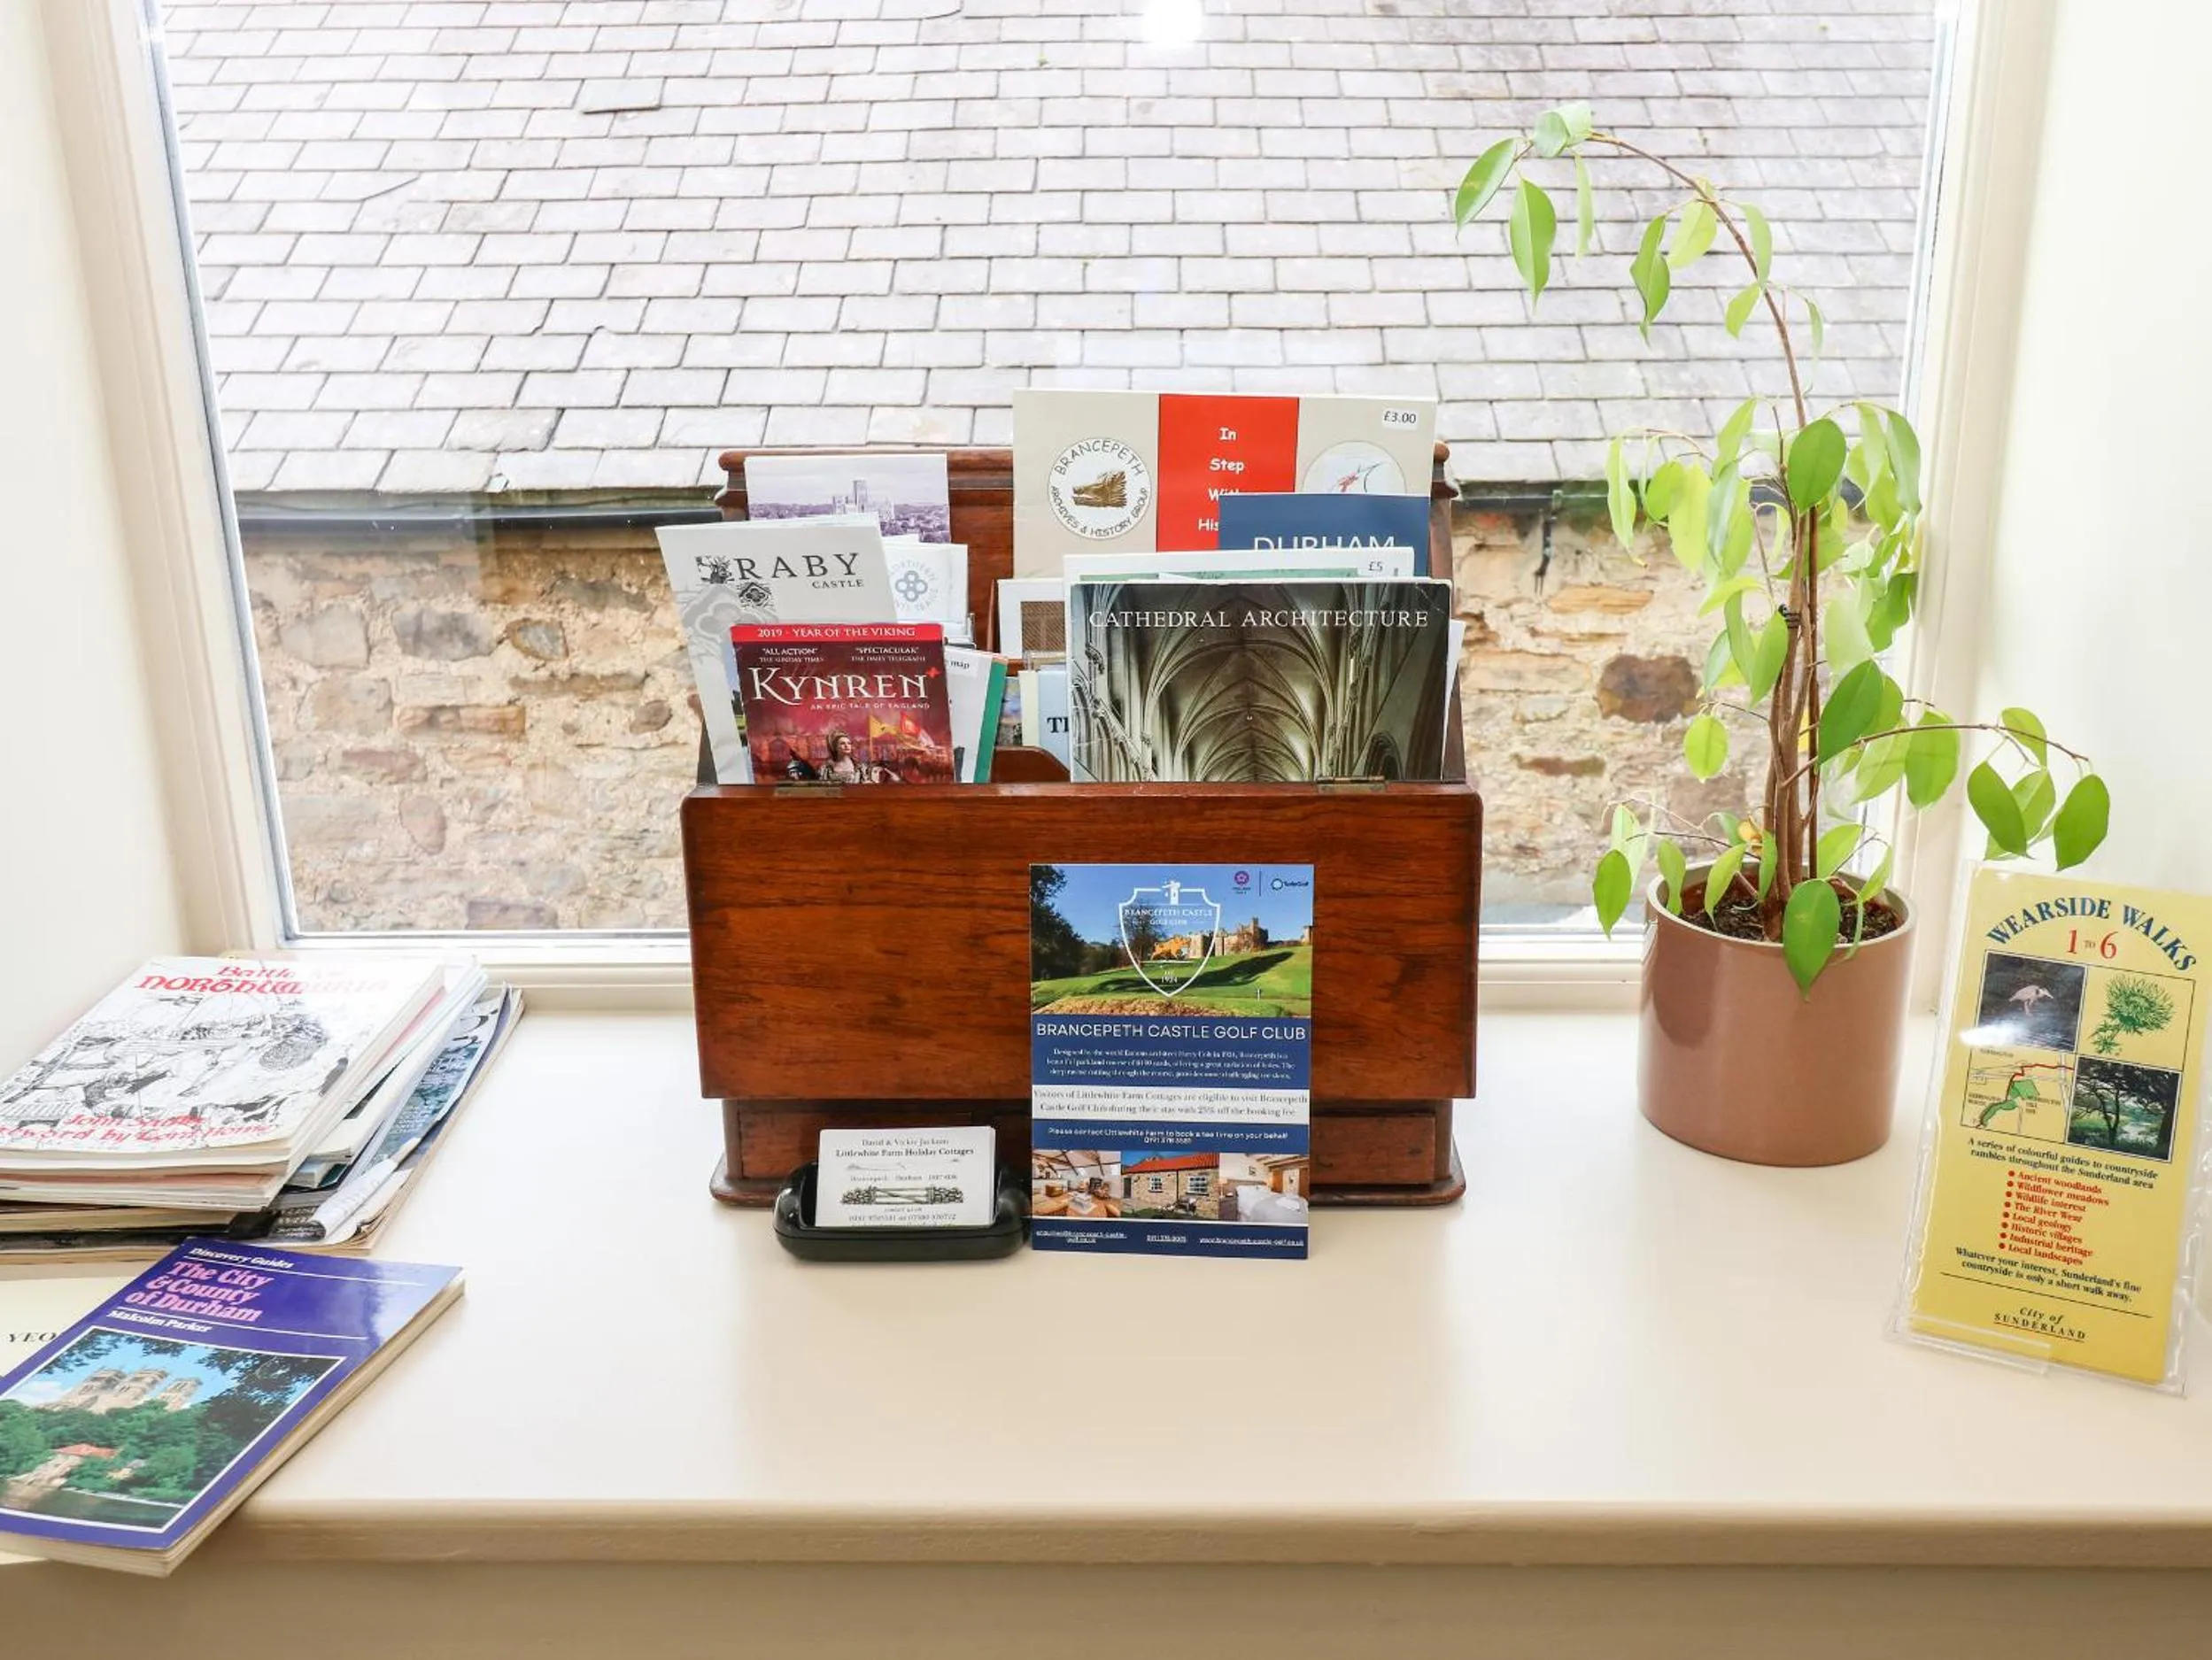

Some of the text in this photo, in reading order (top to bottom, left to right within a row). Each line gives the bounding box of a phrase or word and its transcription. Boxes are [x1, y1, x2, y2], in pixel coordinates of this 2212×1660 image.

[1383, 411, 1417, 424] £3.00
[1219, 428, 1237, 441] In
[1055, 440, 1145, 475] BRANCEPETH
[1209, 458, 1245, 473] Step
[1051, 486, 1080, 529] ARCHIVES
[1090, 518, 1132, 537] HISTORY
[1130, 488, 1149, 518] GROUP
[733, 552, 859, 580] RABY
[1368, 561, 1383, 572] £5
[812, 579, 864, 589] CASTLE
[1089, 610, 1428, 628] CATHEDRAL ARCHITECTURE
[758, 627, 916, 638] 2019 YEAR OF THE VIKING
[1985, 897, 2196, 971] WEARSIDE WALKS
[2066, 930, 2078, 954] 1
[2100, 931, 2118, 959] 6
[1036, 1023, 1306, 1040] BRANCEPETH CASTLE GOLF CLUB
[1065, 1090, 1075, 1099] of
[1145, 1092, 1182, 1103] Cottages
[1260, 1094, 1308, 1105] Brancepeth
[1067, 1103, 1086, 1113] Golf
[905, 1148, 937, 1157] Holiday
[939, 1147, 974, 1156] Cottages
[1968, 1137, 2159, 1180] A series of colourful guides to countryside
[1970, 1149, 2154, 1190] rambles throughout the Sunderland area
[2018, 1171, 2102, 1193] Ancient woodlands
[2015, 1192, 2086, 1212] Wildlife interest
[2017, 1181, 2109, 1205] Wildflower meadows
[2013, 1213, 2072, 1232] Local geology
[2015, 1202, 2083, 1223] The River Wear
[2011, 1223, 2083, 1244] Historic villages
[2008, 1244, 2083, 1265] Local landscapes
[2009, 1233, 2093, 1257] Industrial heritage
[189, 1247, 295, 1269] Discovery Guides
[166, 1261, 275, 1289] The City
[1955, 1247, 1997, 1262] Whatever
[1997, 1256, 2019, 1267] your
[2061, 1269, 2122, 1289] Sunderland's
[2123, 1281, 2142, 1293] fine
[1961, 1260, 2014, 1277] countryside
[2015, 1270, 2024, 1279] is
[2026, 1273, 2046, 1286] only
[2055, 1279, 2080, 1291] short
[2083, 1285, 2104, 1296] walk
[2107, 1290, 2132, 1303] away.
[125, 1291, 264, 1323] of Durham
[2020, 1306, 2064, 1324] City of
[106, 1309, 213, 1333] Malcolm Parker
[1994, 1313, 2085, 1340] SUNDERLAND
